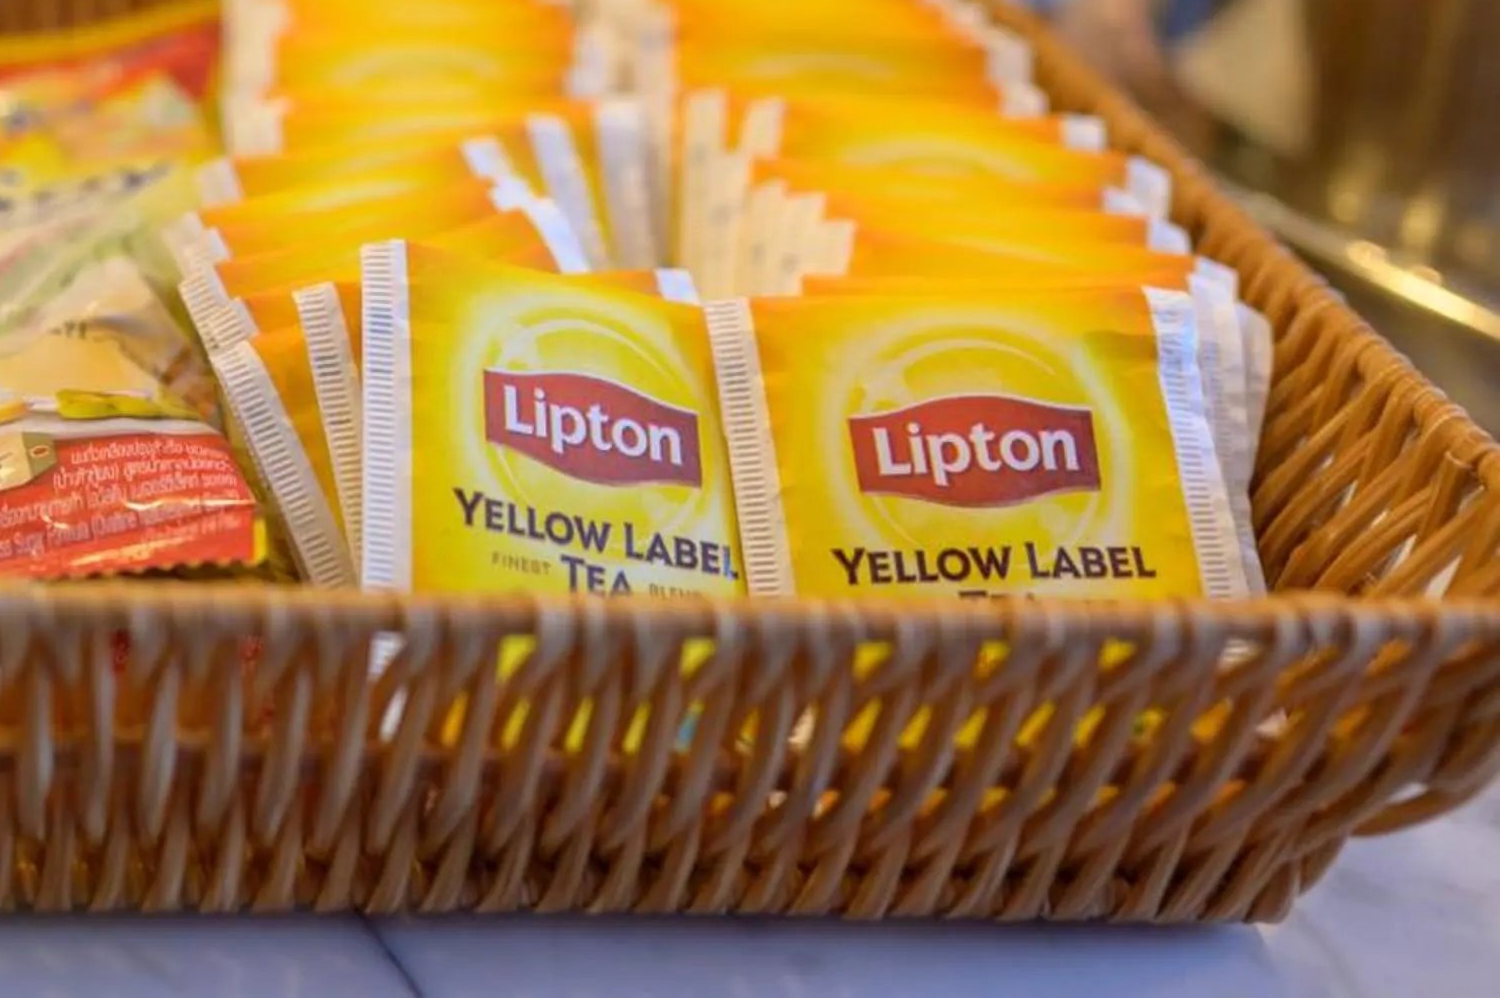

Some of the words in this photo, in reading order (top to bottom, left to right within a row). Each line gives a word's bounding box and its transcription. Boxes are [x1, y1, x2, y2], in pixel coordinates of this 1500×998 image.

[503, 385, 683, 466] Lipton
[872, 422, 1080, 486] Lipton
[452, 488, 612, 553] YELLOW
[623, 522, 739, 580] LABEL
[832, 546, 1011, 586] YELLOW
[1026, 542, 1157, 579] LABEL
[491, 552, 551, 575] FINEST
[560, 554, 632, 597] TEA
